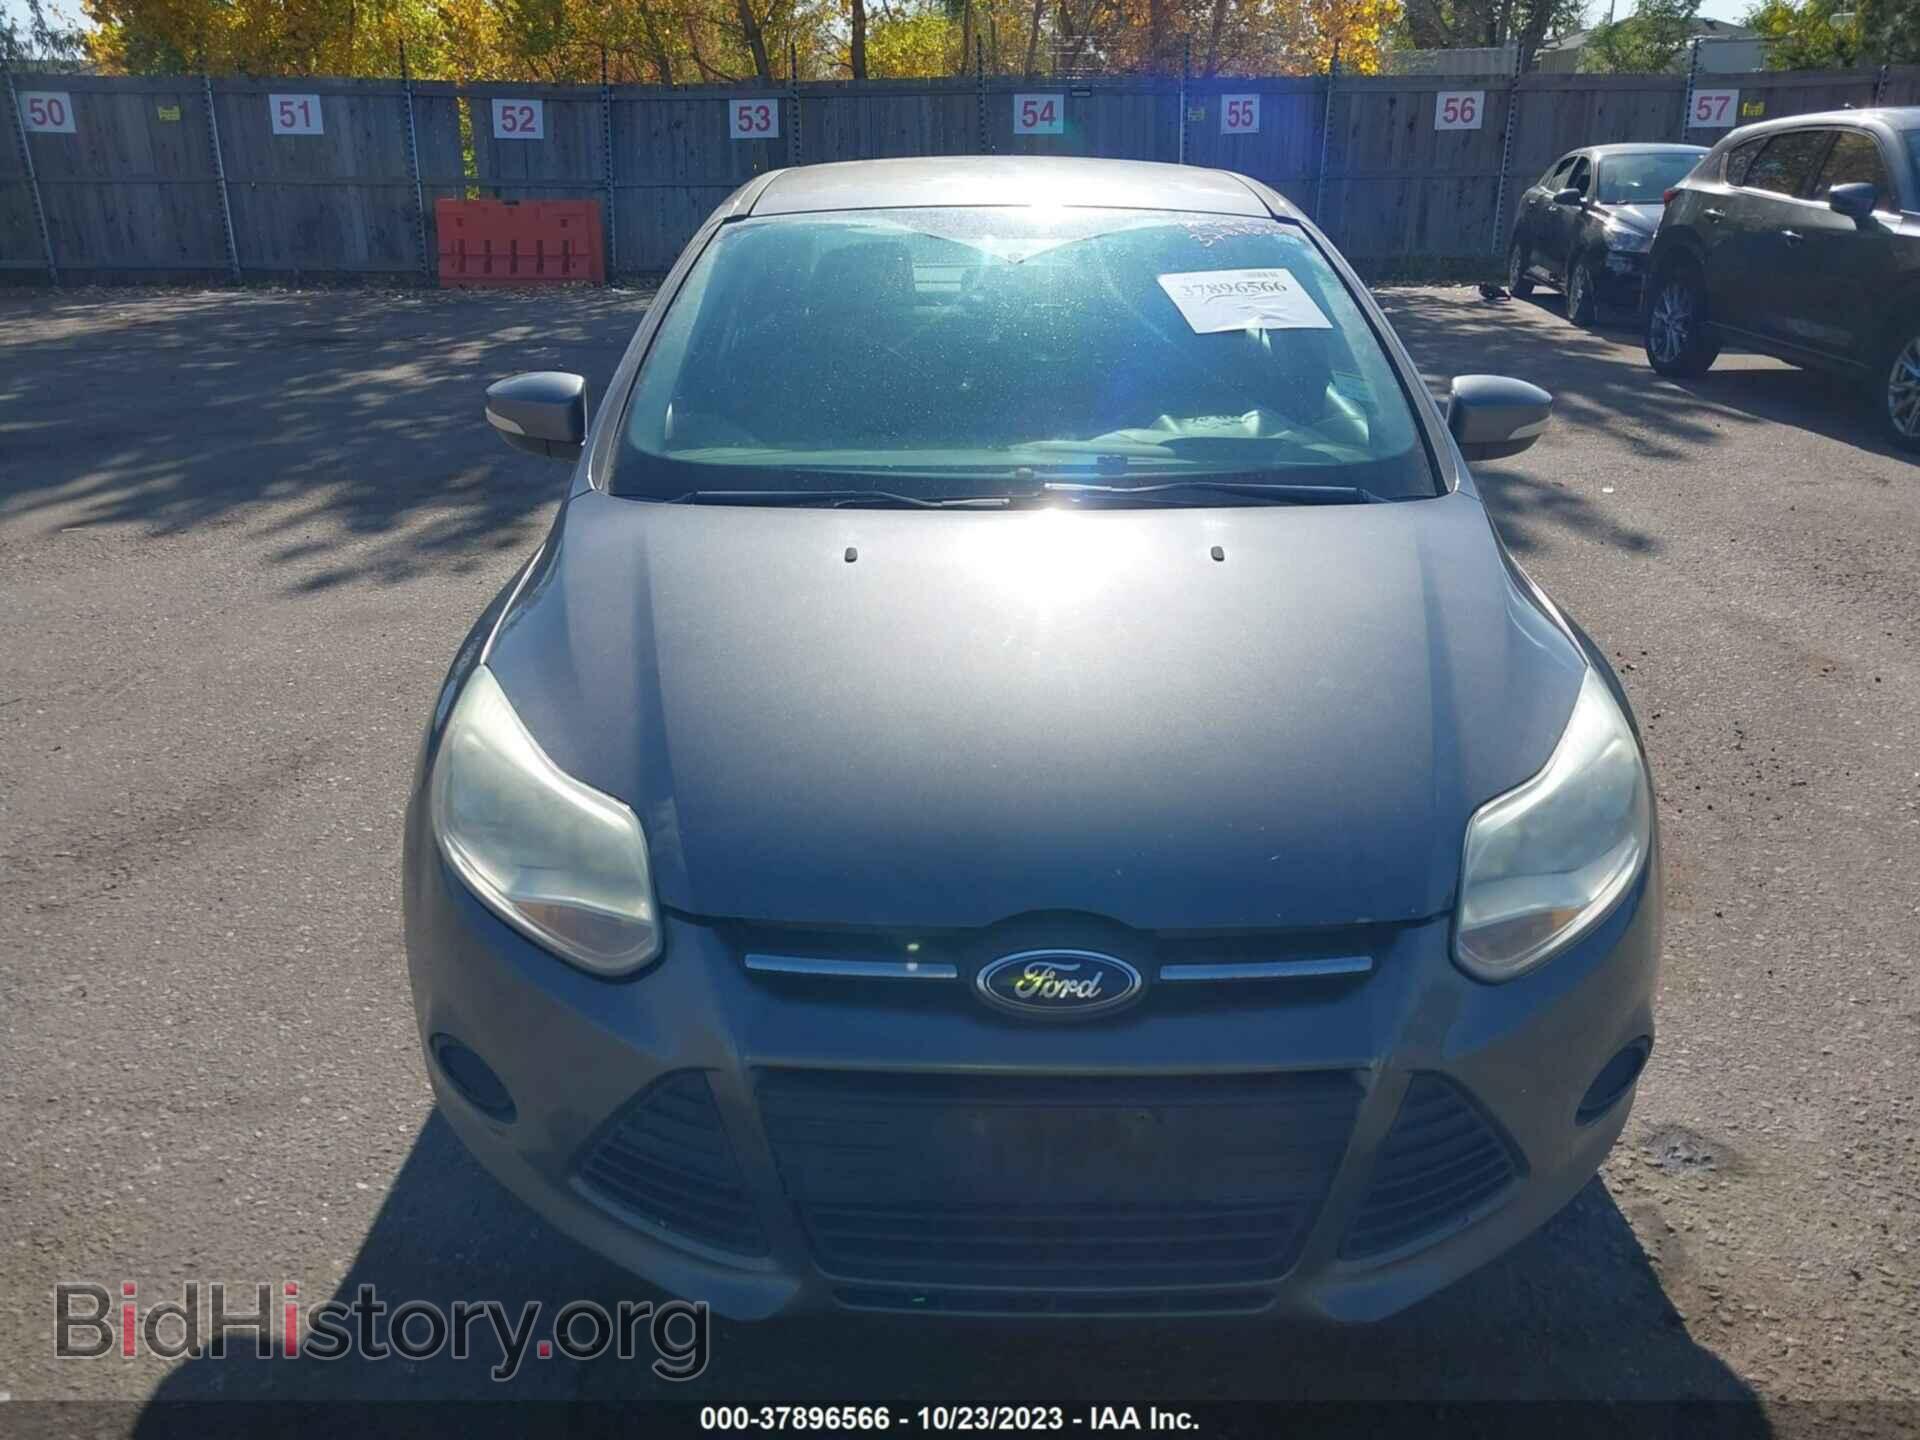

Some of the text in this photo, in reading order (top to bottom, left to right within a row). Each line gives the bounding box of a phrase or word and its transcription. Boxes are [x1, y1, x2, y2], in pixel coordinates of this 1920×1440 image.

[29, 98, 65, 125] 50
[279, 101, 311, 127] 51
[501, 105, 536, 133] 52
[738, 105, 771, 132] 53
[1021, 100, 1056, 128] 54
[1227, 100, 1253, 127] 55
[1443, 97, 1475, 123] 56
[1695, 95, 1731, 121] 57
[1182, 280, 1288, 297] 37896566
[1013, 961, 1104, 998] Ford
